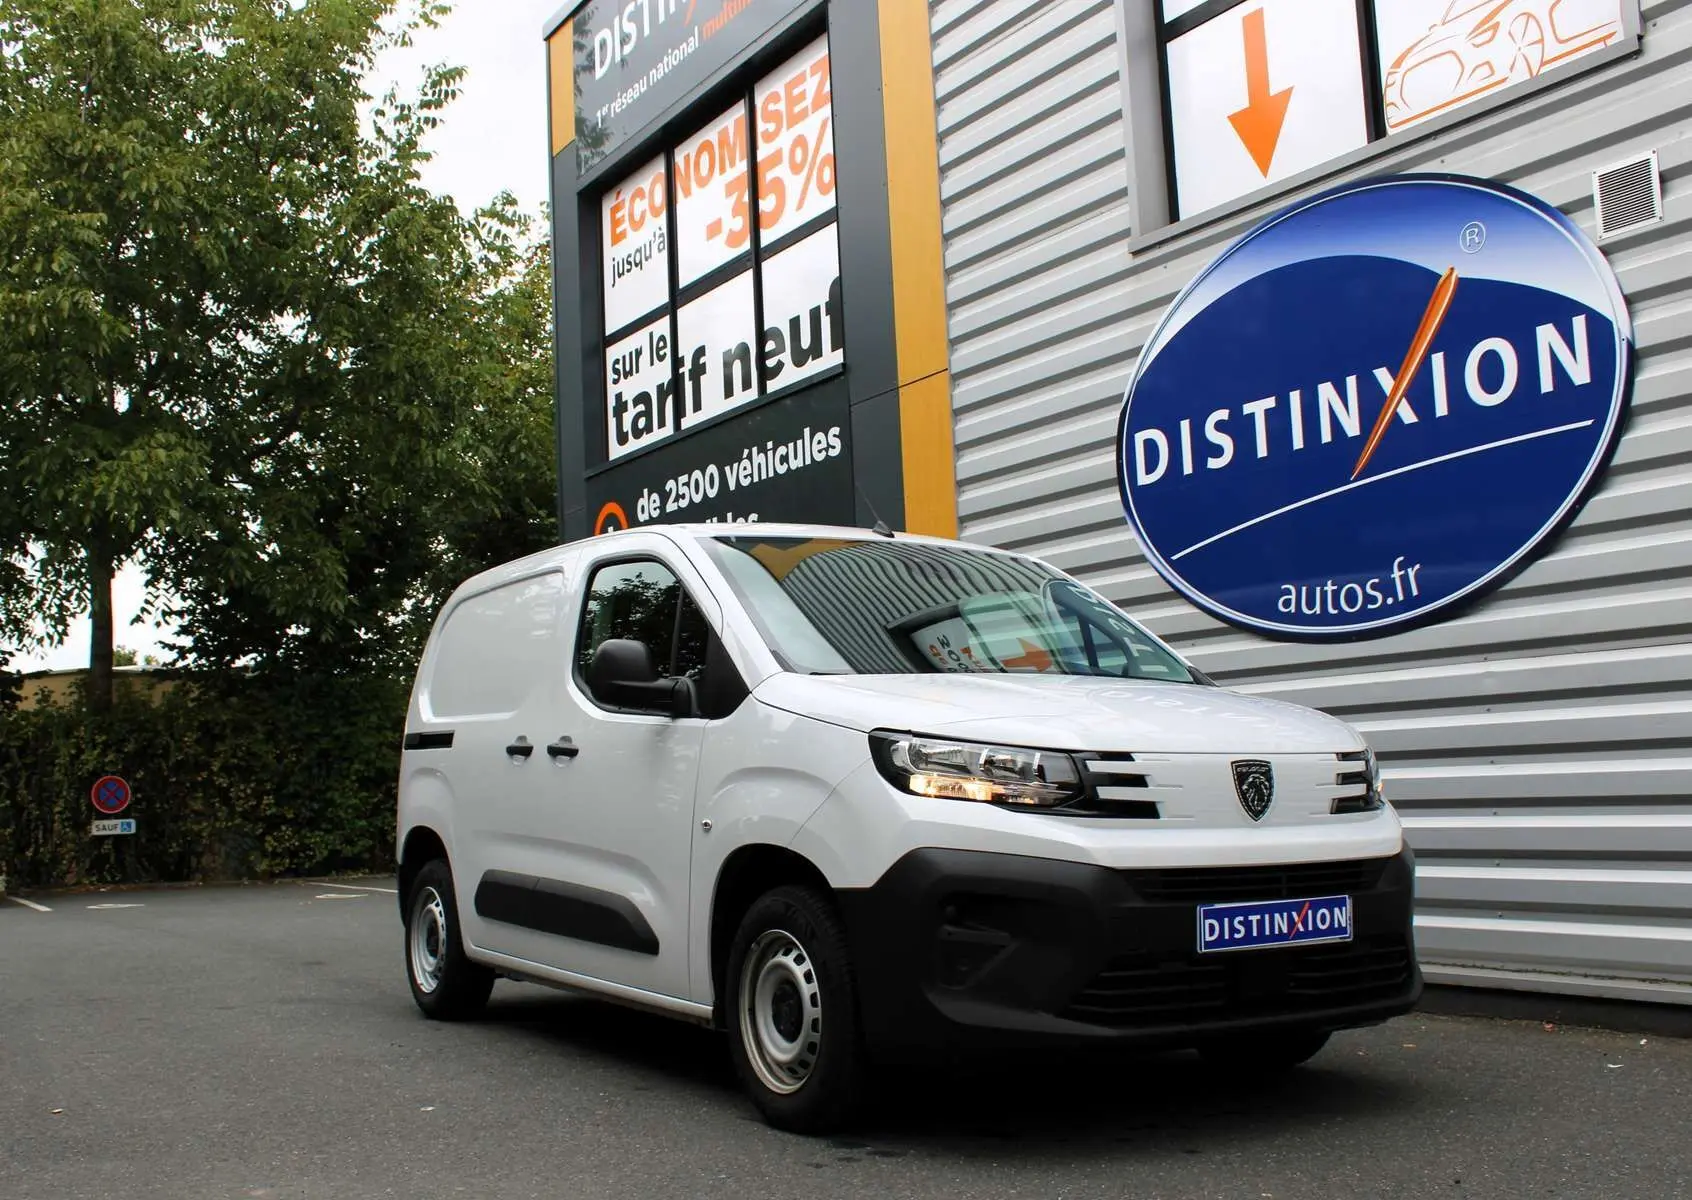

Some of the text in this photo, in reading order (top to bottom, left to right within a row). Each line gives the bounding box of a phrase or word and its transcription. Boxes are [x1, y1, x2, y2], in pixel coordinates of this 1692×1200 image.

[610, 76, 647, 118] réseau
[649, 26, 699, 87] national
[610, 55, 832, 247] ÉCONOMSEZ
[706, 117, 836, 249] -35%
[611, 226, 666, 288] jusqu'à
[612, 331, 669, 386] sur le
[612, 344, 707, 447] tarif
[1133, 266, 1593, 486] DISTINXION
[636, 426, 842, 523] de 2500 véhicules
[1277, 556, 1422, 616] autos.fr
[94, 823, 119, 832] SAUF
[1204, 902, 1347, 942] DISTINXION
